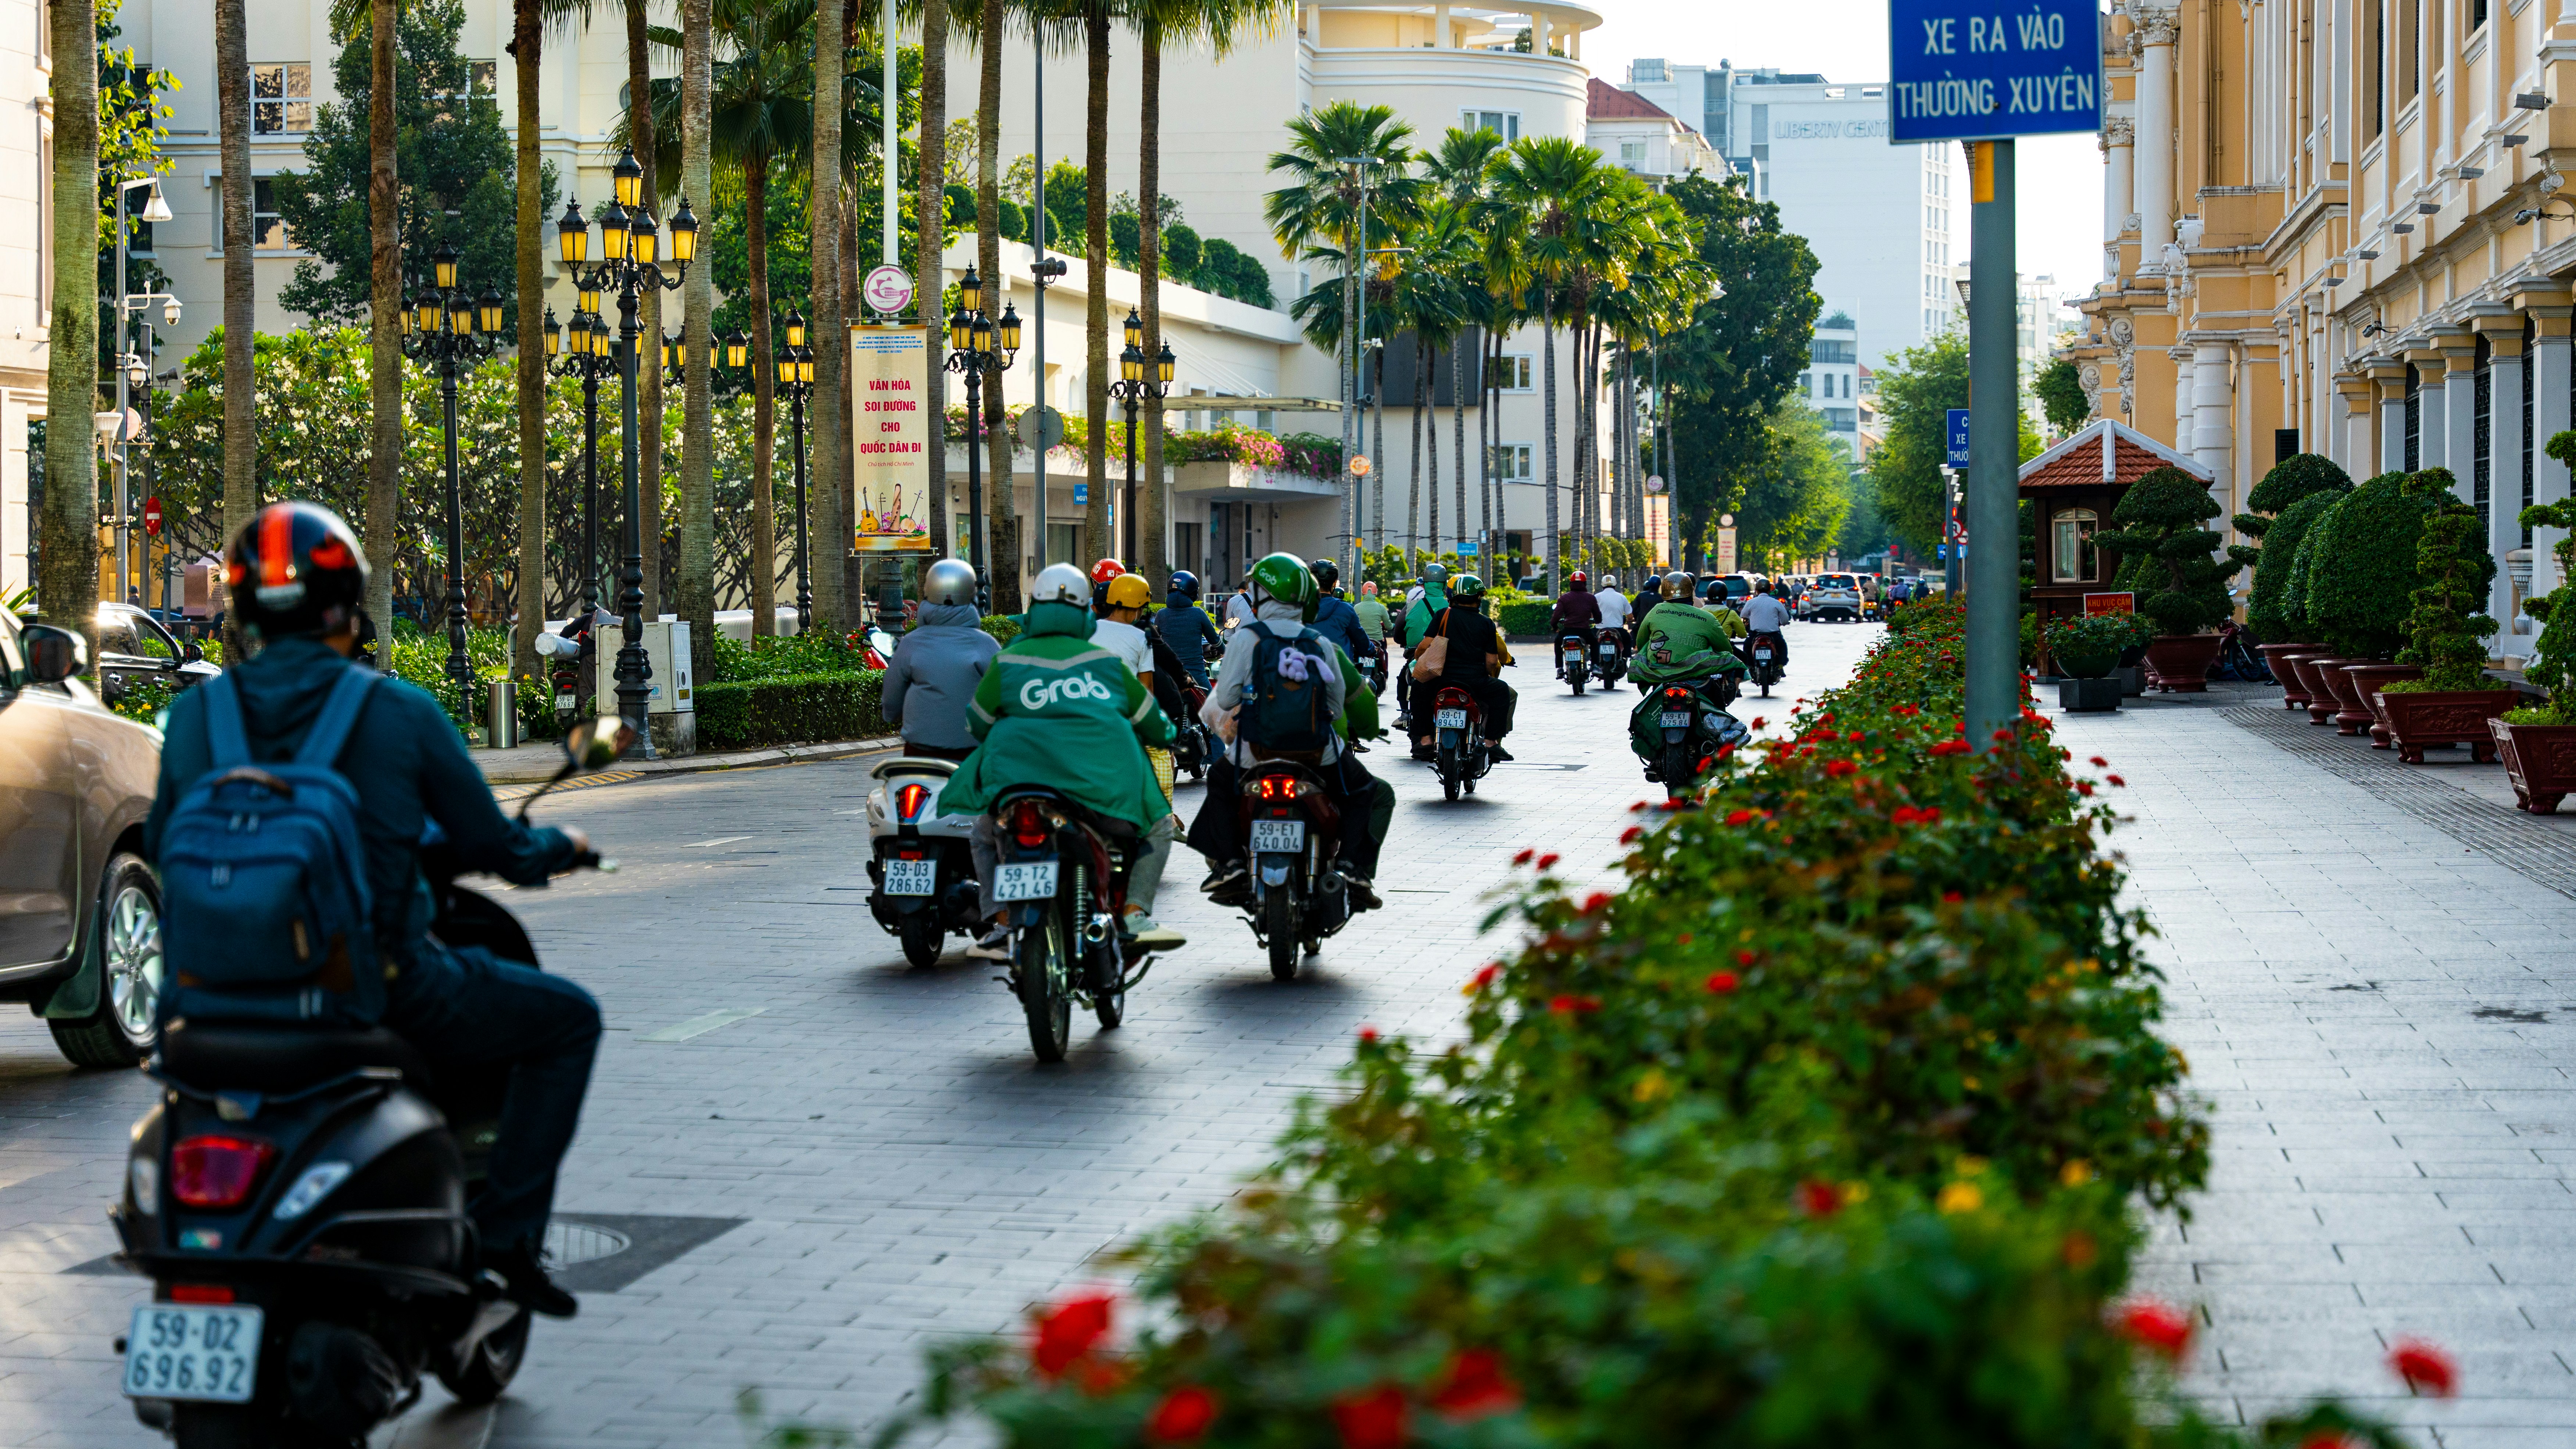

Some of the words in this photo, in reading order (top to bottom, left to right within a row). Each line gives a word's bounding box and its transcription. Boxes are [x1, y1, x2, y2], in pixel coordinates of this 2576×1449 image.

[1923, 18, 1956, 55] XE
[1970, 16, 2007, 53] RA
[2017, 4, 2064, 51] VÀO
[1896, 70, 1995, 119] THƯỜNG
[2009, 66, 2094, 114] XUYÊN
[1776, 121, 1842, 139] LIBERTY
[1844, 119, 1889, 137] CENT
[869, 378, 888, 390] VĂN
[891, 378, 910, 390] HÓA
[865, 401, 880, 411] SOI
[883, 399, 916, 411] ĐƯỜNG
[881, 422, 900, 432] CHO
[1956, 433, 1966, 444] XE
[861, 440, 886, 454] QUỐC
[889, 441, 908, 452] DÂN
[912, 443, 921, 452] ĐI
[1949, 447, 1968, 462] THƯỜ
[1259, 568, 1277, 585] Grab
[1656, 609, 1707, 622] Giaohangtietkiem
[1020, 672, 1110, 710] Grab
[1438, 719, 1463, 727] 894.13
[1259, 823, 1294, 836] 59-E1
[1253, 837, 1299, 850] 640.04
[892, 862, 928, 877] 59-D3
[1005, 866, 1048, 882] 59-T2
[888, 878, 930, 893] 286.62
[998, 881, 1052, 899] 421.46
[131, 1350, 246, 1393] 696.92
